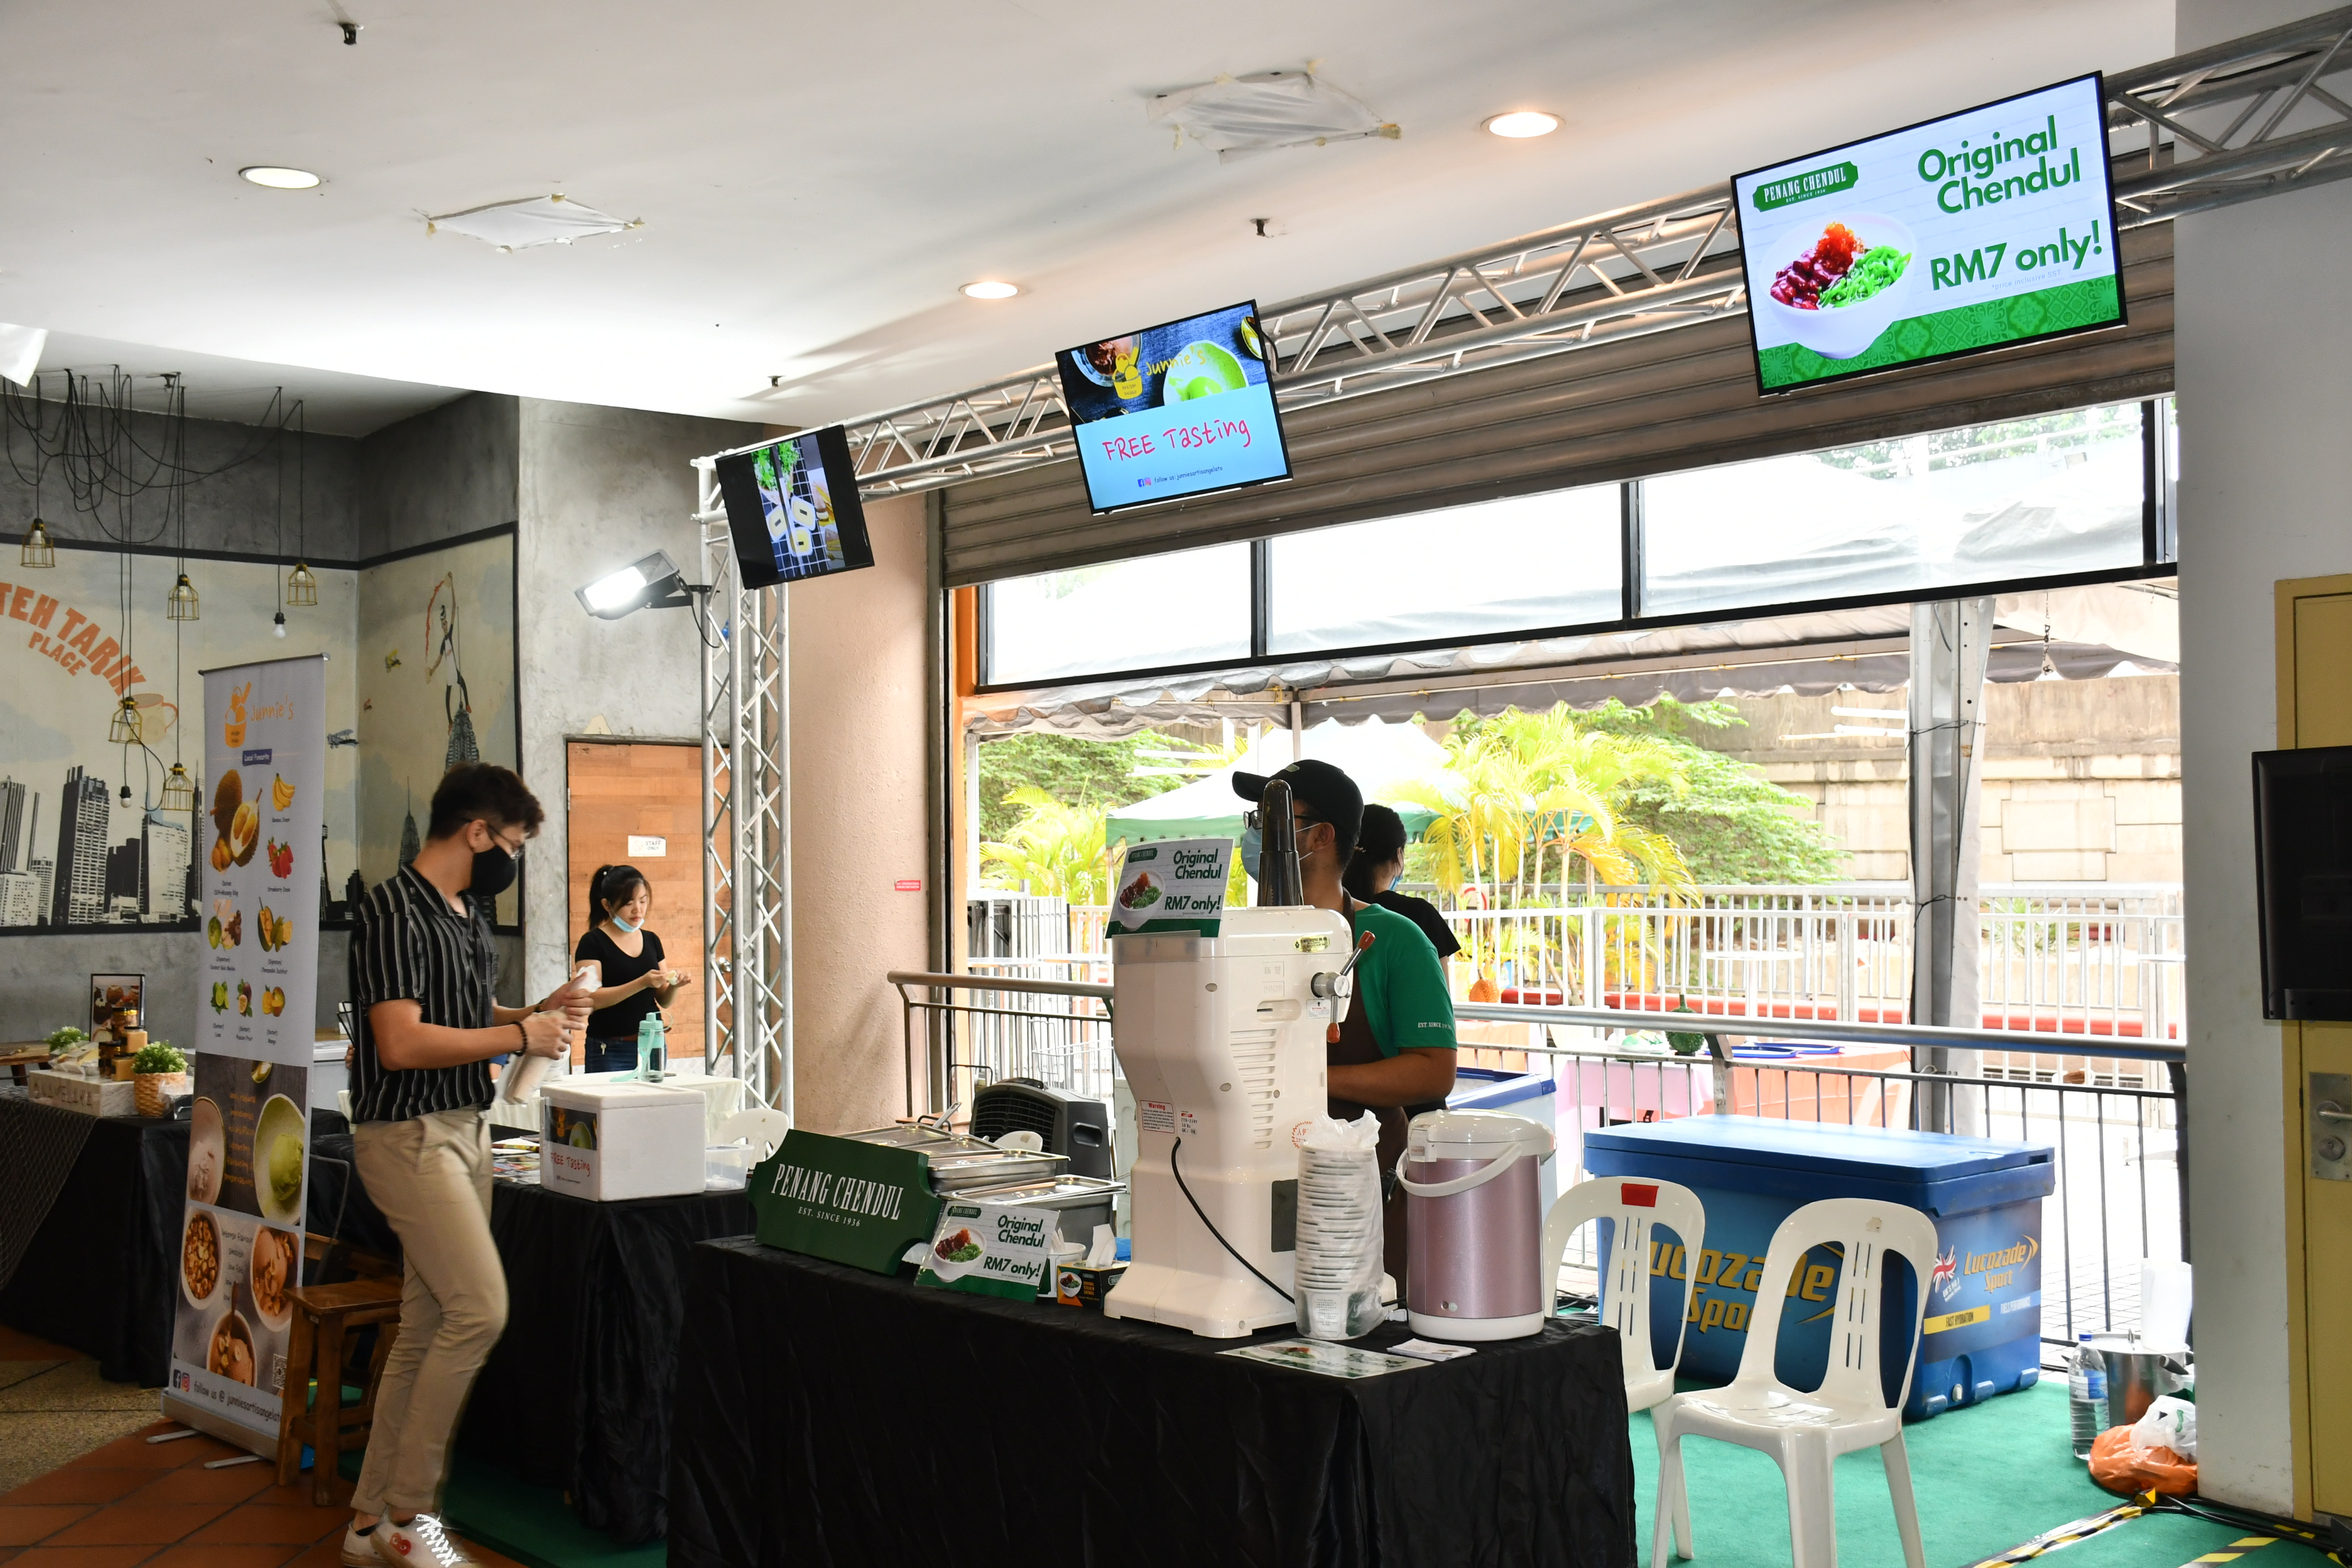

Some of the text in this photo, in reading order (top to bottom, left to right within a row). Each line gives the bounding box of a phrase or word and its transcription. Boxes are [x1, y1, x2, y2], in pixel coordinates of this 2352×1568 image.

[1918, 114, 2057, 182] Original
[1763, 167, 1846, 203] PENANG CHENDUL
[1937, 147, 2081, 214] Chendul
[1930, 220, 2102, 291] RM7 only!
[2014, 274, 2045, 286] inclusive
[2048, 270, 2060, 278] SST
[1146, 345, 1206, 377] Junnie's
[1102, 419, 1251, 462] FREE Tasting
[0, 582, 146, 697] TEH TARIK
[28, 631, 87, 676] PLACE
[251, 694, 293, 721] Junnie's
[1173, 848, 1219, 867] Original
[1175, 864, 1222, 880] Chendul
[1165, 895, 1222, 914] RM7 only!
[1148, 1102, 1166, 1111] Warning
[550, 1152, 591, 1177] FREE Tasting
[770, 1163, 905, 1221] PENANG CHENDUL
[798, 1206, 861, 1227] EST. SINCE 1936
[997, 1215, 1044, 1233] Original
[998, 1229, 1045, 1248] Chendul
[983, 1256, 1041, 1280] RM7 only!
[1650, 1241, 1835, 1302] ucozae
[1963, 1241, 2027, 1276] Lucozade
[1984, 1270, 2013, 1294] Sport
[1681, 1286, 1753, 1334] Spo
[1946, 1311, 1974, 1328] FAST HYDRATION
[194, 1381, 210, 1396] follow
[211, 1390, 217, 1399] us
[227, 1393, 280, 1422] junniesartisangelat
